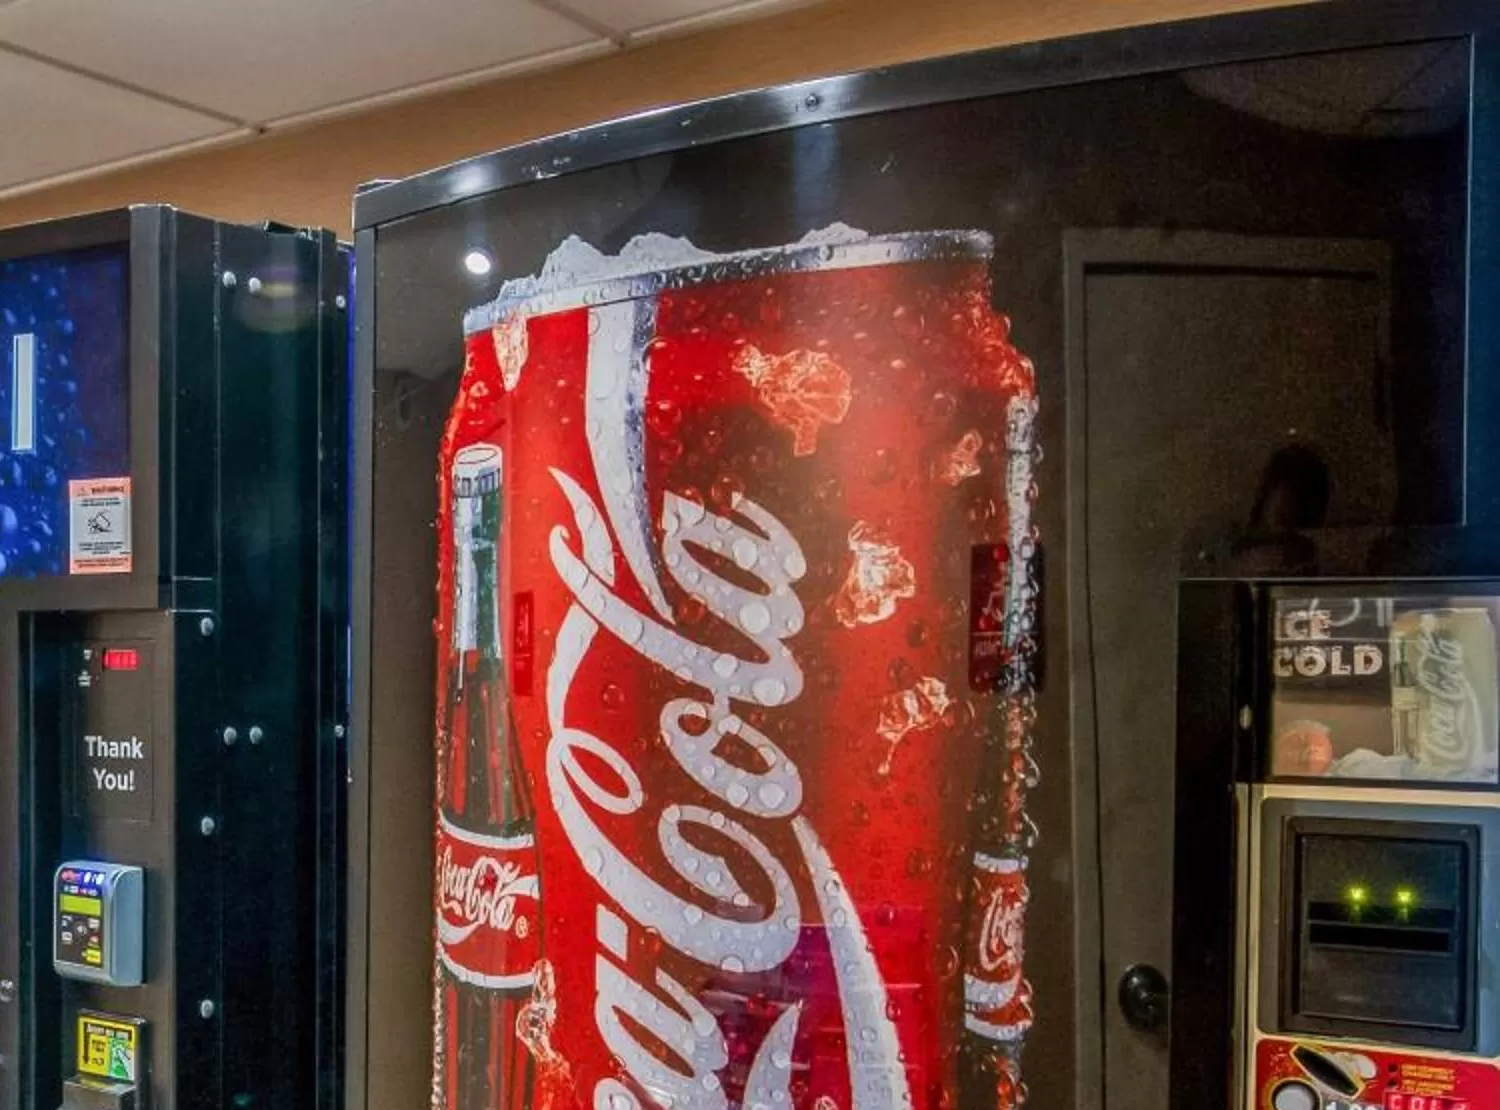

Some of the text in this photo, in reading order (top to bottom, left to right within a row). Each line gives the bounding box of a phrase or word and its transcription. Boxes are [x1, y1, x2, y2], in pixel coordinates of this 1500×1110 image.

[1273, 645, 1383, 677] COLD
[84, 736, 145, 760] Thank
[93, 769, 136, 791] You!
